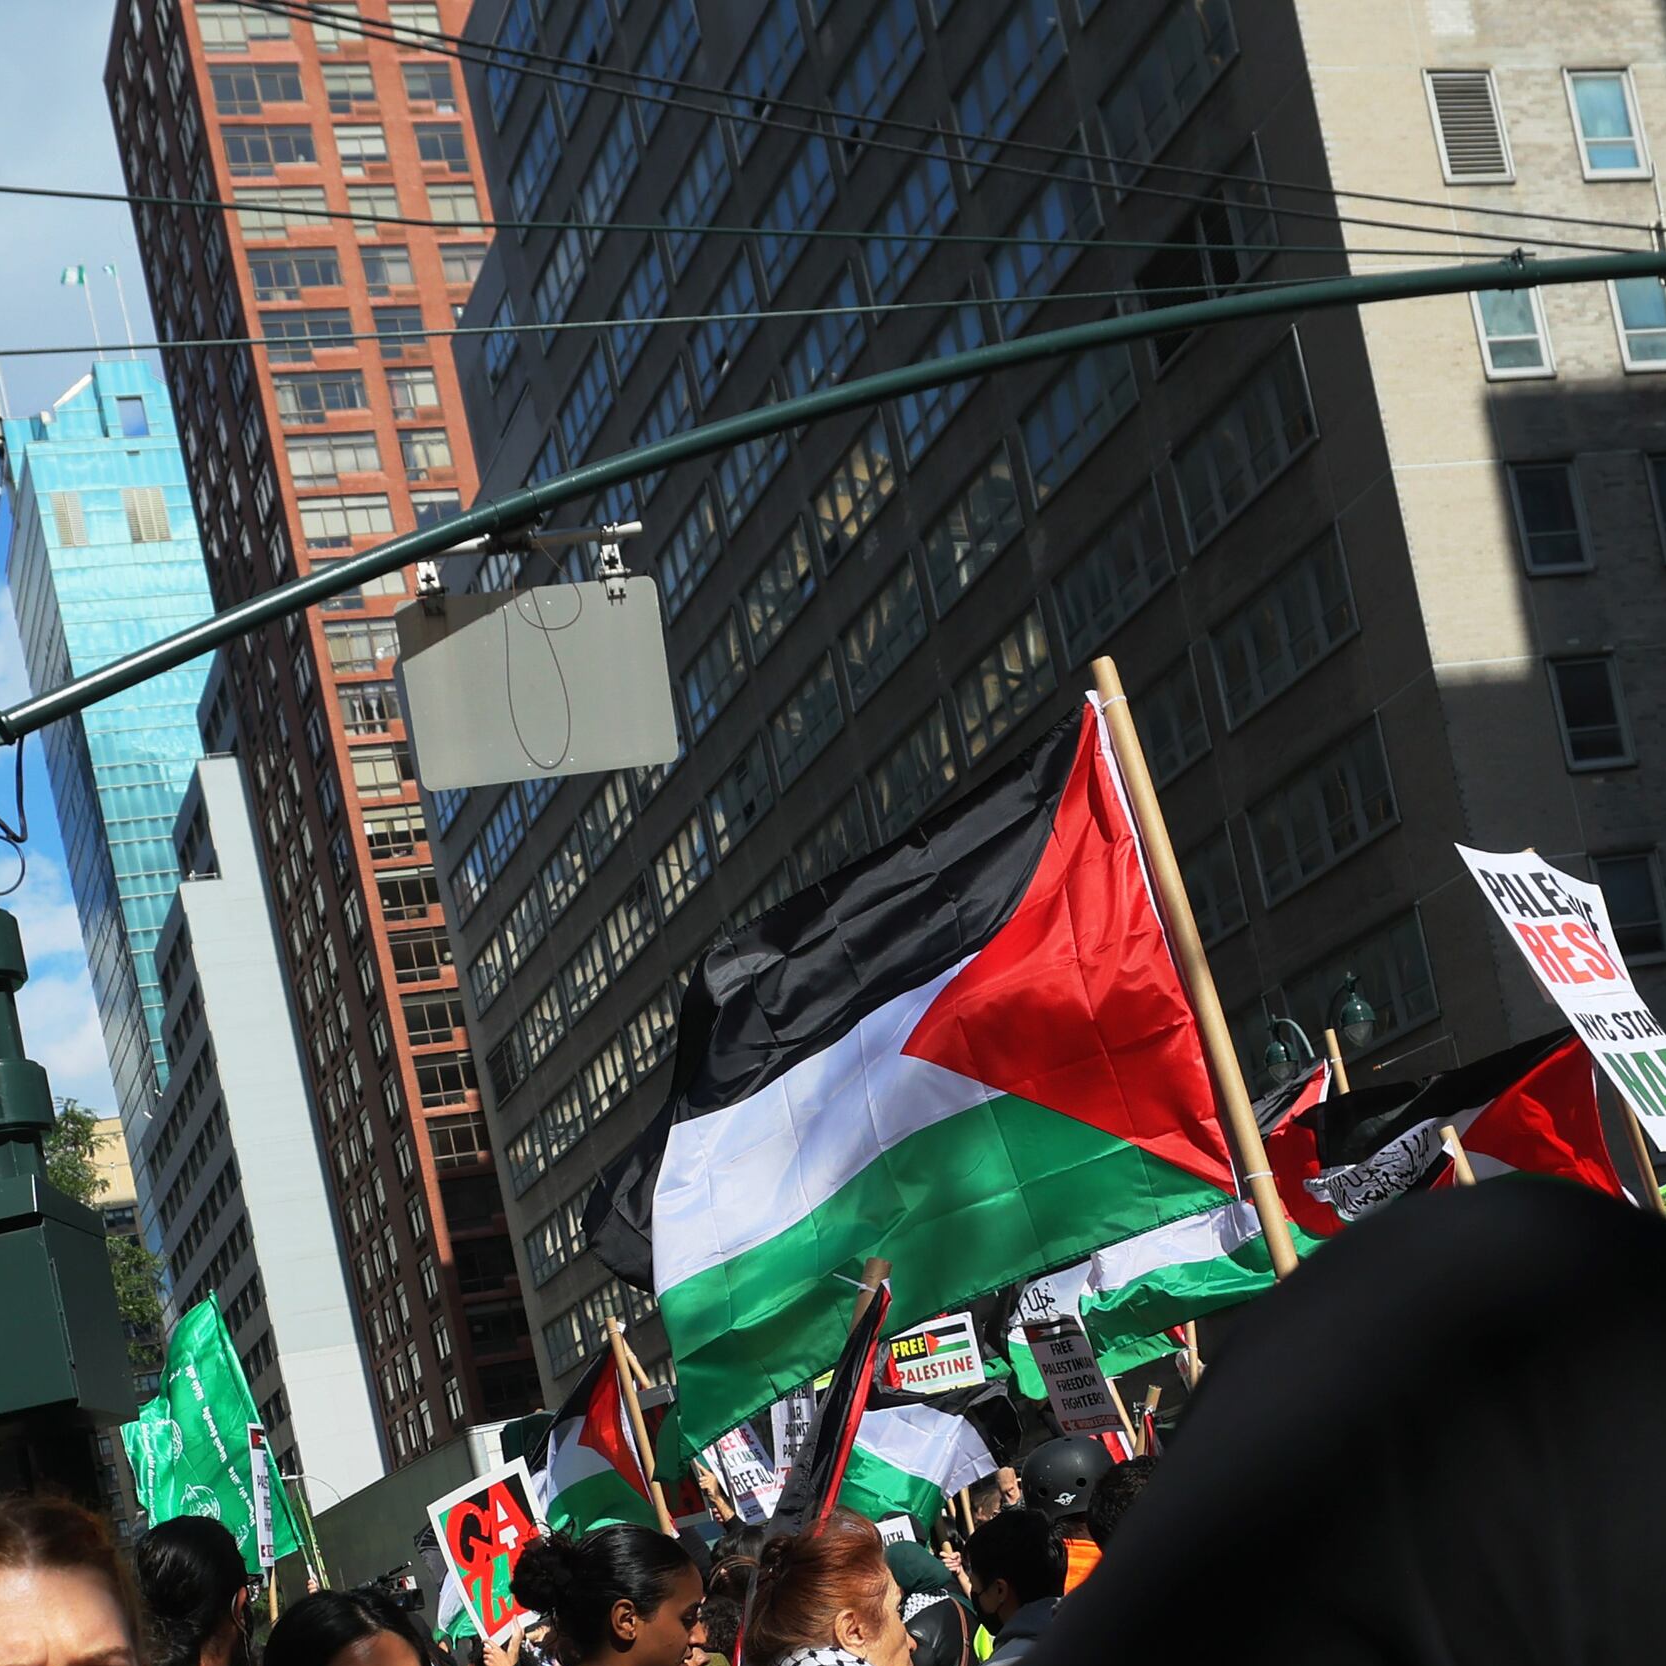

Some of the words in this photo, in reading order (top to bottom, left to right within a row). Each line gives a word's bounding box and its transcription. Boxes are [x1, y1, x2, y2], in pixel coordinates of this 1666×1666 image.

[1513, 922, 1626, 984] RES
[1574, 1012, 1618, 1041] NYC
[891, 1336, 926, 1359] FREE
[1050, 1340, 1074, 1356] FREE
[899, 1355, 974, 1384] PALESTINE
[732, 1467, 759, 1494] REE
